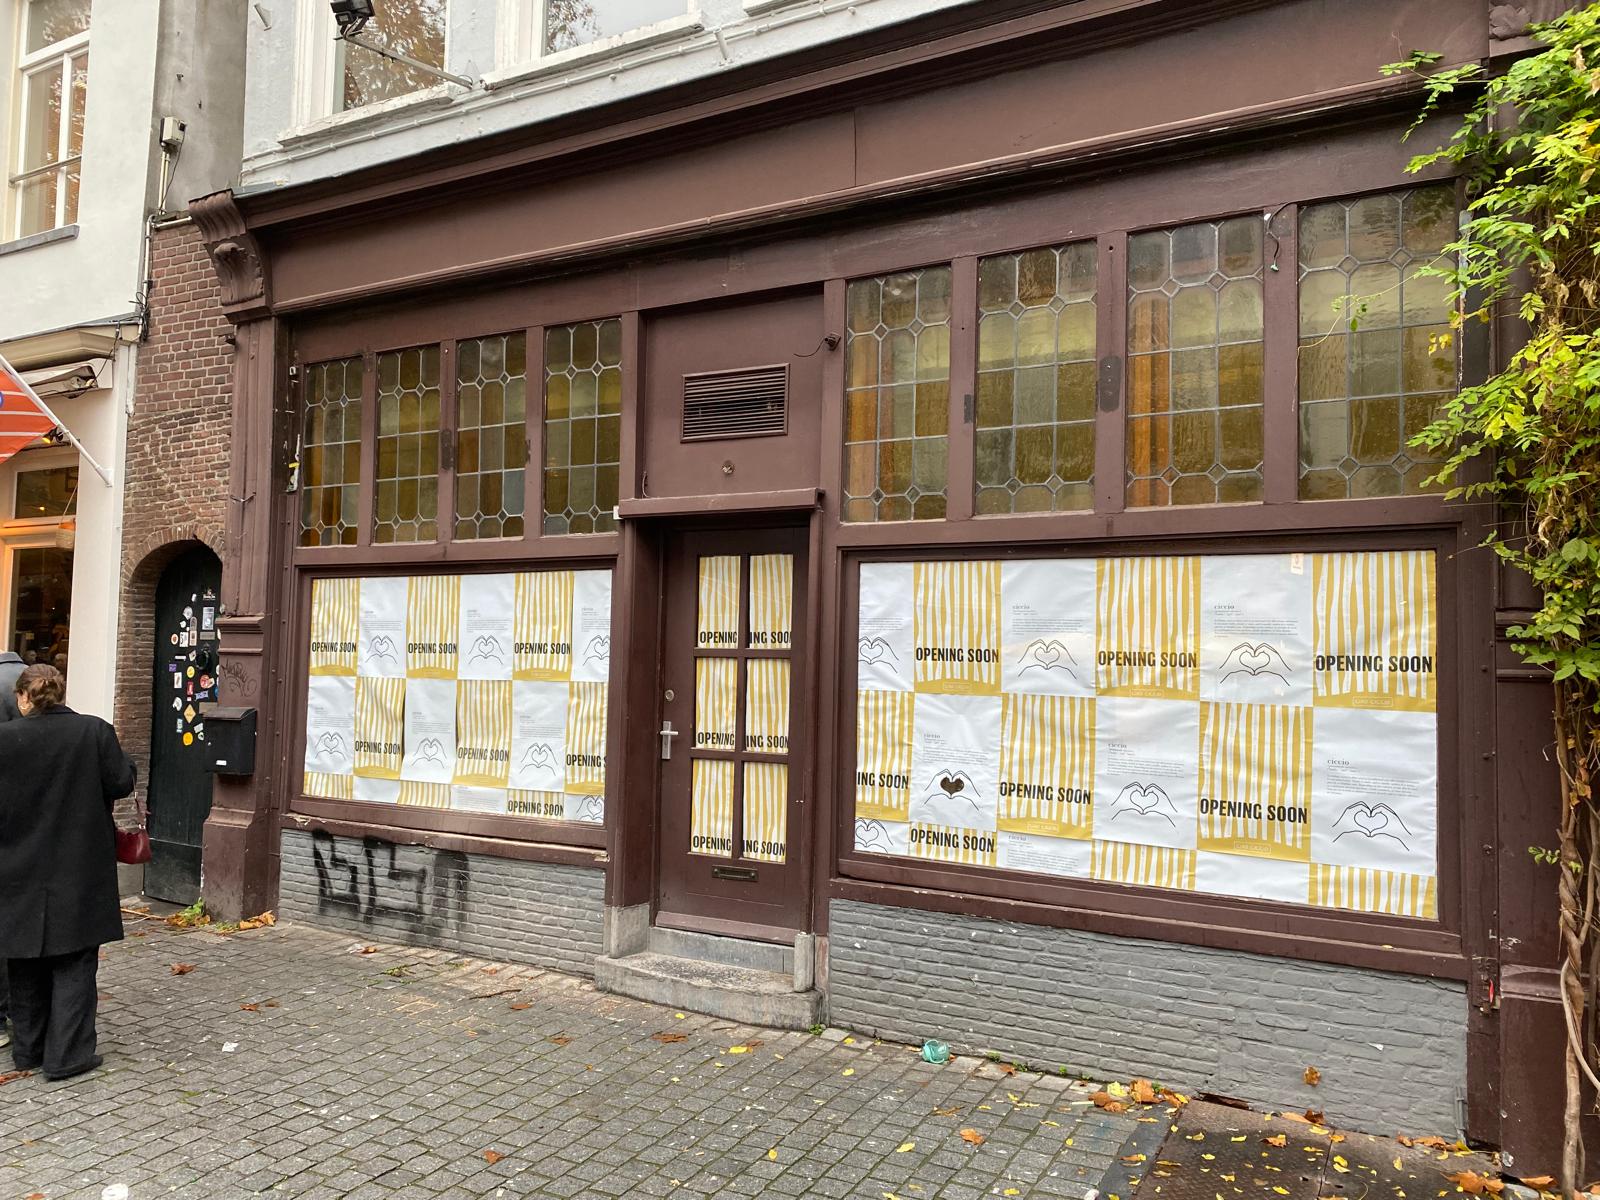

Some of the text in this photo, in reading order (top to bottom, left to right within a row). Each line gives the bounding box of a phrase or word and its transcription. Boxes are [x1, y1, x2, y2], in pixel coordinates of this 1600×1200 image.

[700, 631, 738, 644] OPENING
[312, 642, 356, 653] OPENING SOON
[408, 643, 457, 654] OPENING SOON
[514, 643, 571, 655] OPENING SOON
[916, 647, 999, 663] OPENING SOON
[1099, 650, 1197, 668] OPENING SOON
[1315, 655, 1433, 673] OPENING SOON
[697, 732, 735, 746] OPENING
[746, 735, 764, 748] ING
[355, 741, 400, 755] OPENING SOON
[458, 747, 509, 761] OPENING SOON
[566, 754, 602, 767] OPENING
[857, 771, 909, 790] ING SOON
[1000, 781, 1091, 805] OPENING SOON
[508, 800, 564, 817] OPENING SOON
[1200, 798, 1308, 824] OPENING SOON
[693, 835, 732, 851] OPENING
[910, 828, 995, 853] OPENING SOON
[761, 841, 786, 856] SOON
